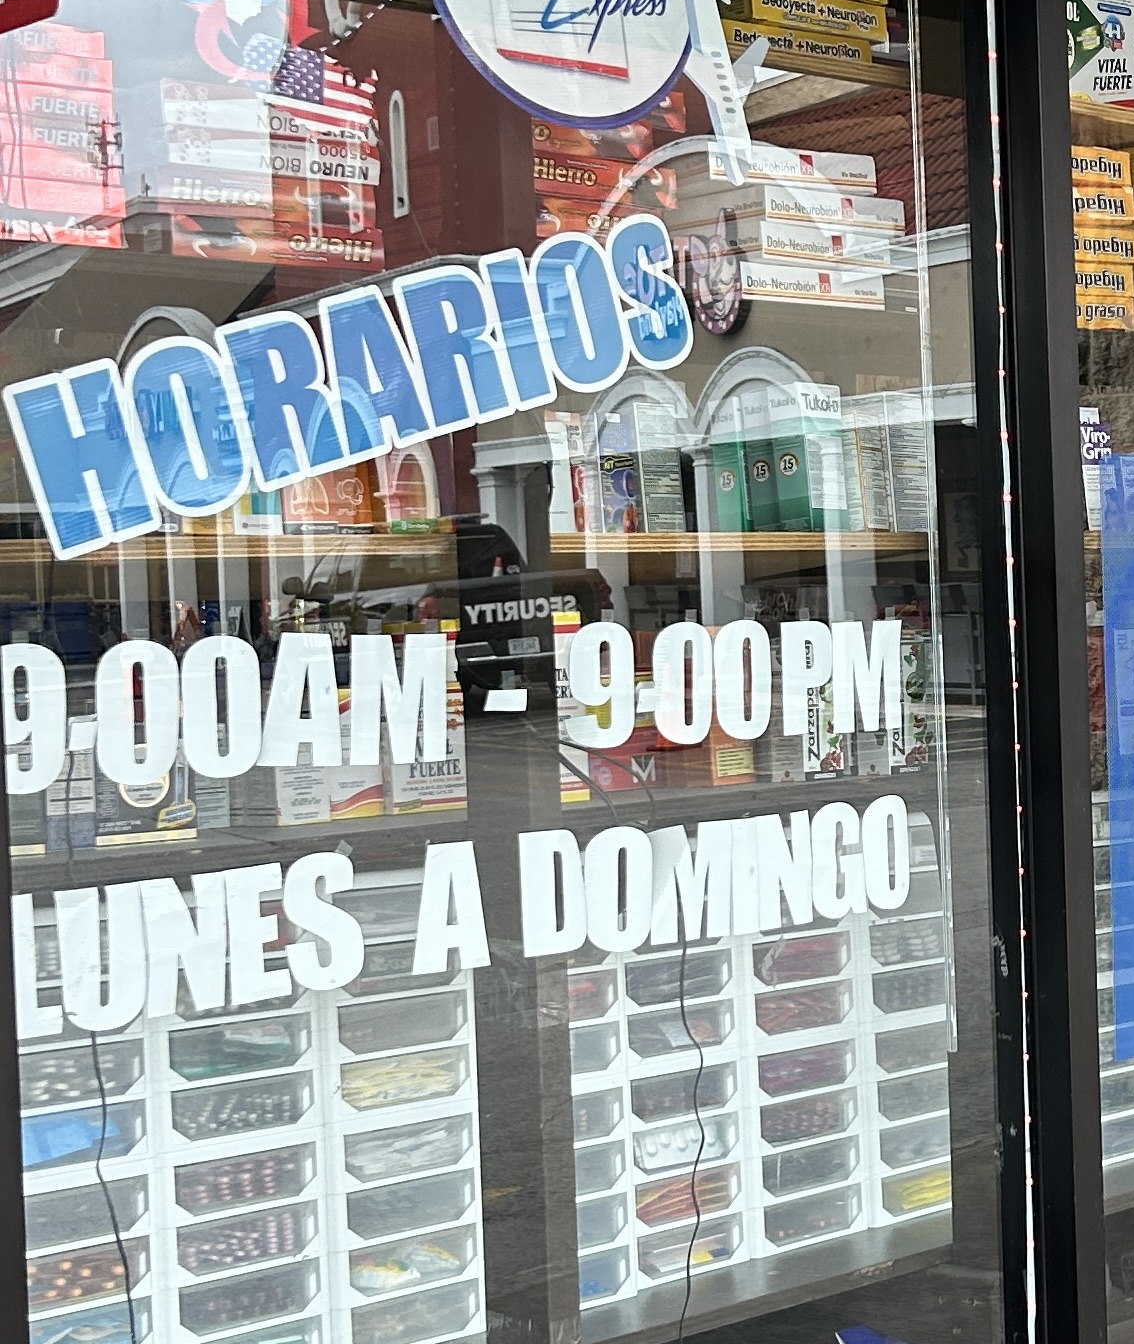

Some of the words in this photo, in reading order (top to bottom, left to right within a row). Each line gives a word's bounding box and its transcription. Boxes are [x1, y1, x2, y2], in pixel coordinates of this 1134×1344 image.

[1097, 57, 1128, 74] VITAL
[1093, 74, 1133, 92] FUERTE
[533, 156, 598, 188] Hierro
[1086, 304, 1126, 323] graso
[3, 213, 695, 561] HORARIOS
[755, 464, 766, 477] 15
[782, 458, 794, 471] 15
[410, 759, 461, 778] FUERTE
[13, 851, 365, 1039] LUNES
[411, 840, 491, 976] A
[518, 794, 911, 959] DOMINGO
